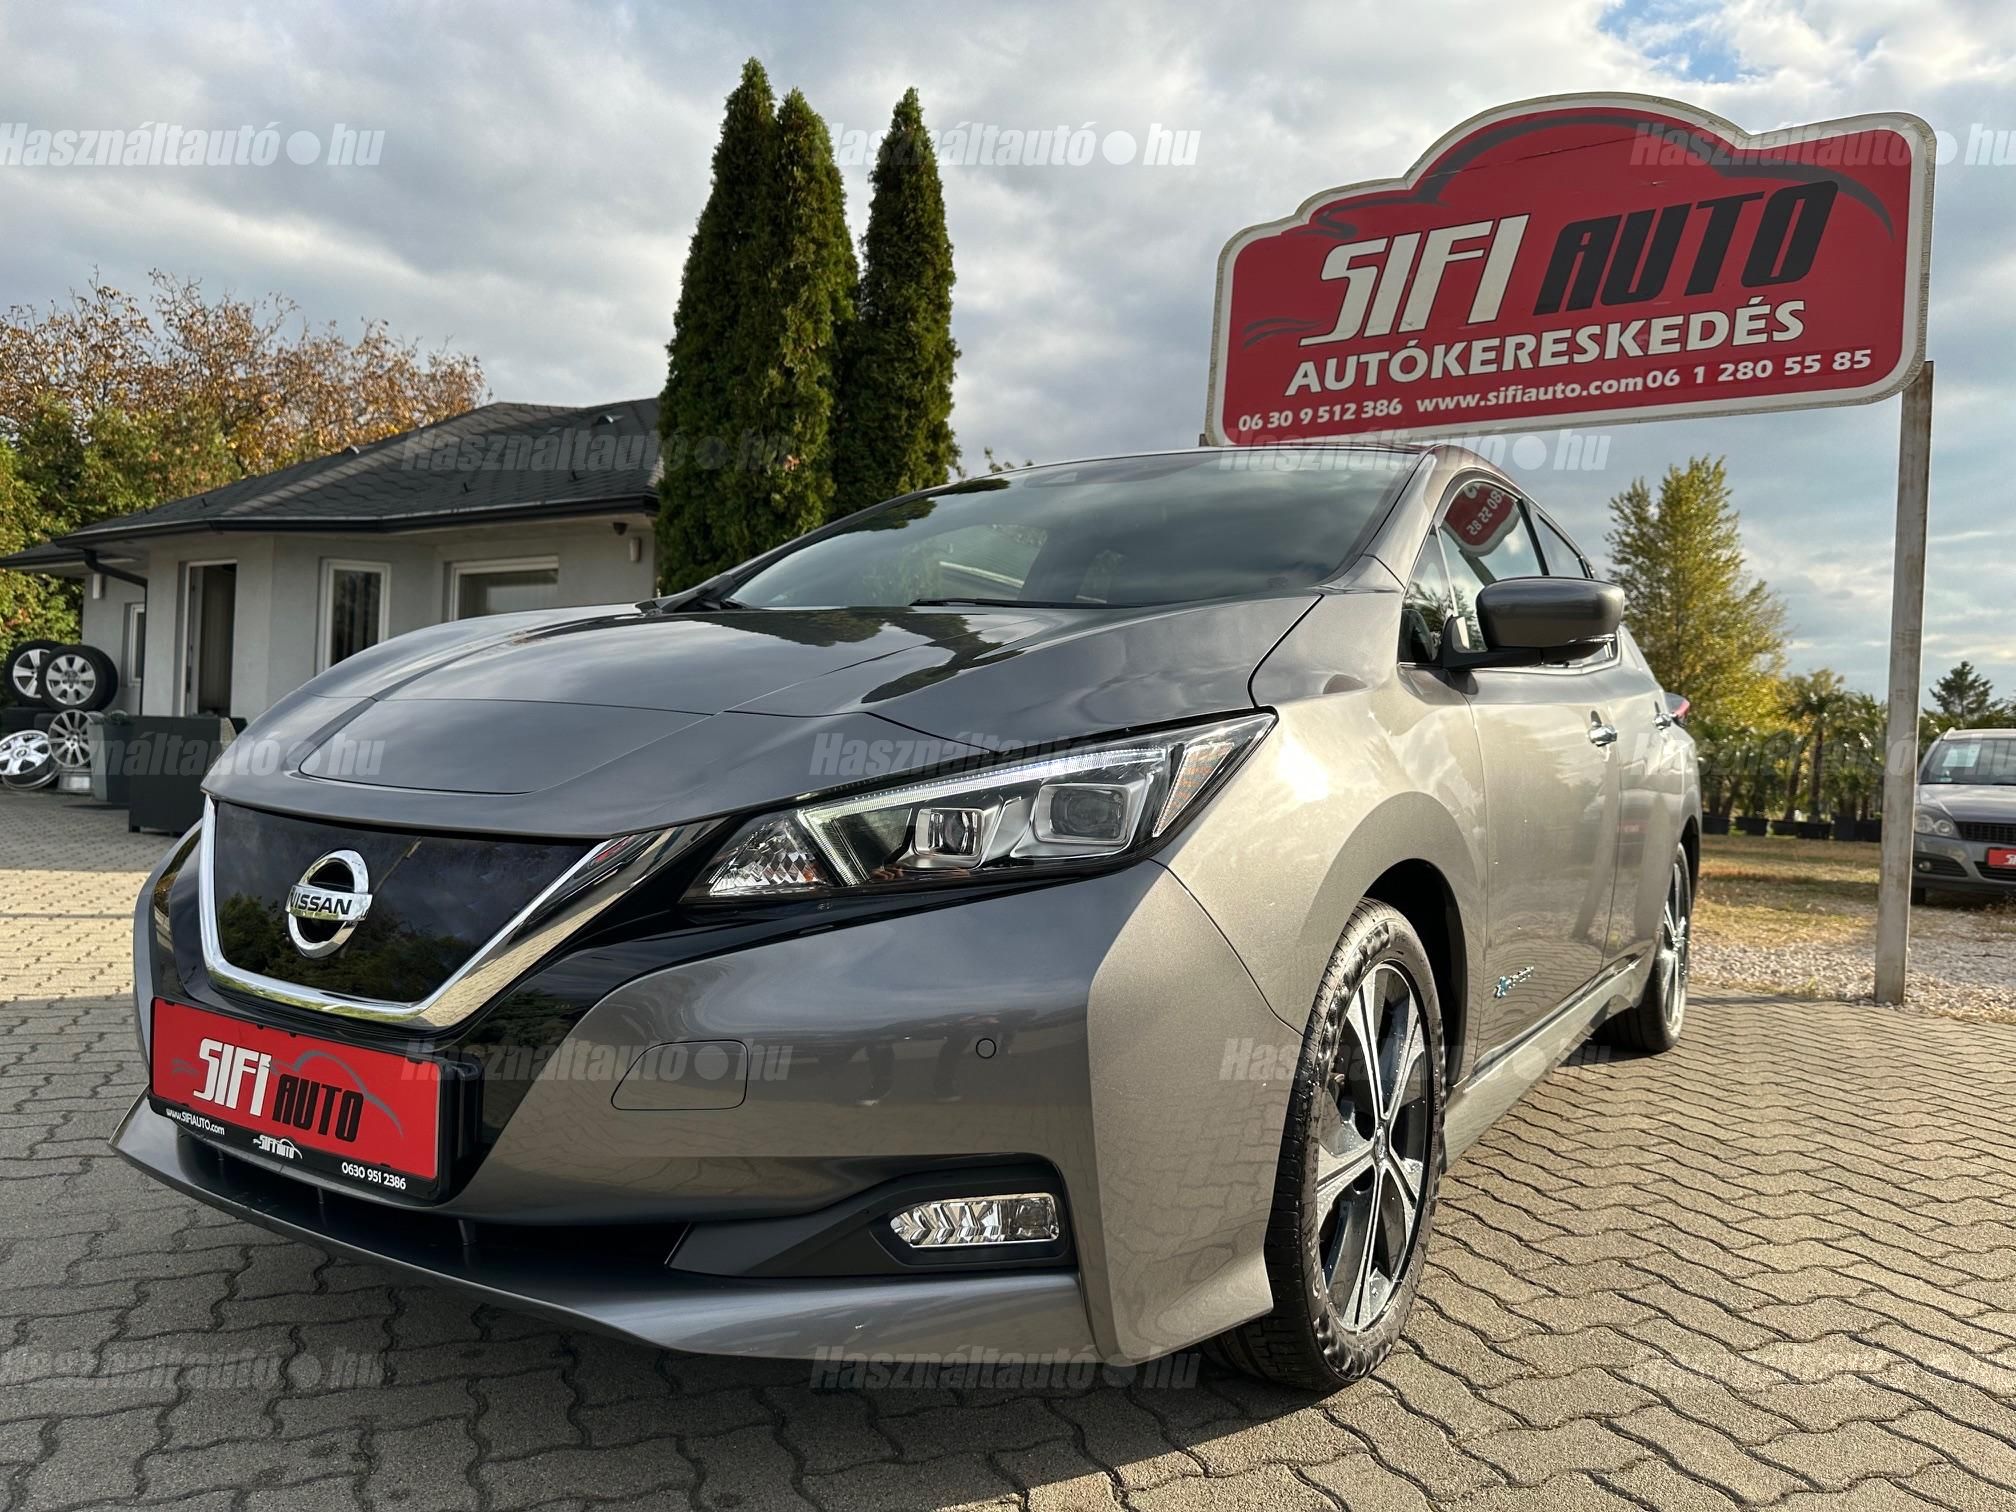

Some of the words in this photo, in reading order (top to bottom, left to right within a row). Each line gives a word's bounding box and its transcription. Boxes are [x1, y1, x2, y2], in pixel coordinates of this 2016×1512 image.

[1298, 214, 1530, 347] SIFI
[1533, 180, 1839, 316] AUTO
[1285, 297, 1806, 397] AUTÓKERESKEDÉS
[1238, 414, 1263, 432] 06
[1267, 410, 1293, 429] 30
[1361, 398, 1402, 419] 386
[1416, 376, 1643, 412] www.sifiauto.com
[1646, 369, 1680, 388] 06
[1693, 366, 1705, 384] 1
[1717, 360, 1773, 382] 280
[1784, 354, 1822, 376] 55
[1832, 349, 1872, 370] 85
[290, 889, 352, 915] NISSAN
[272, 1074, 364, 1142] AUTO
[341, 1161, 365, 1178] 0630
[367, 1168, 381, 1183] 951
[383, 1173, 407, 1190] 2386
